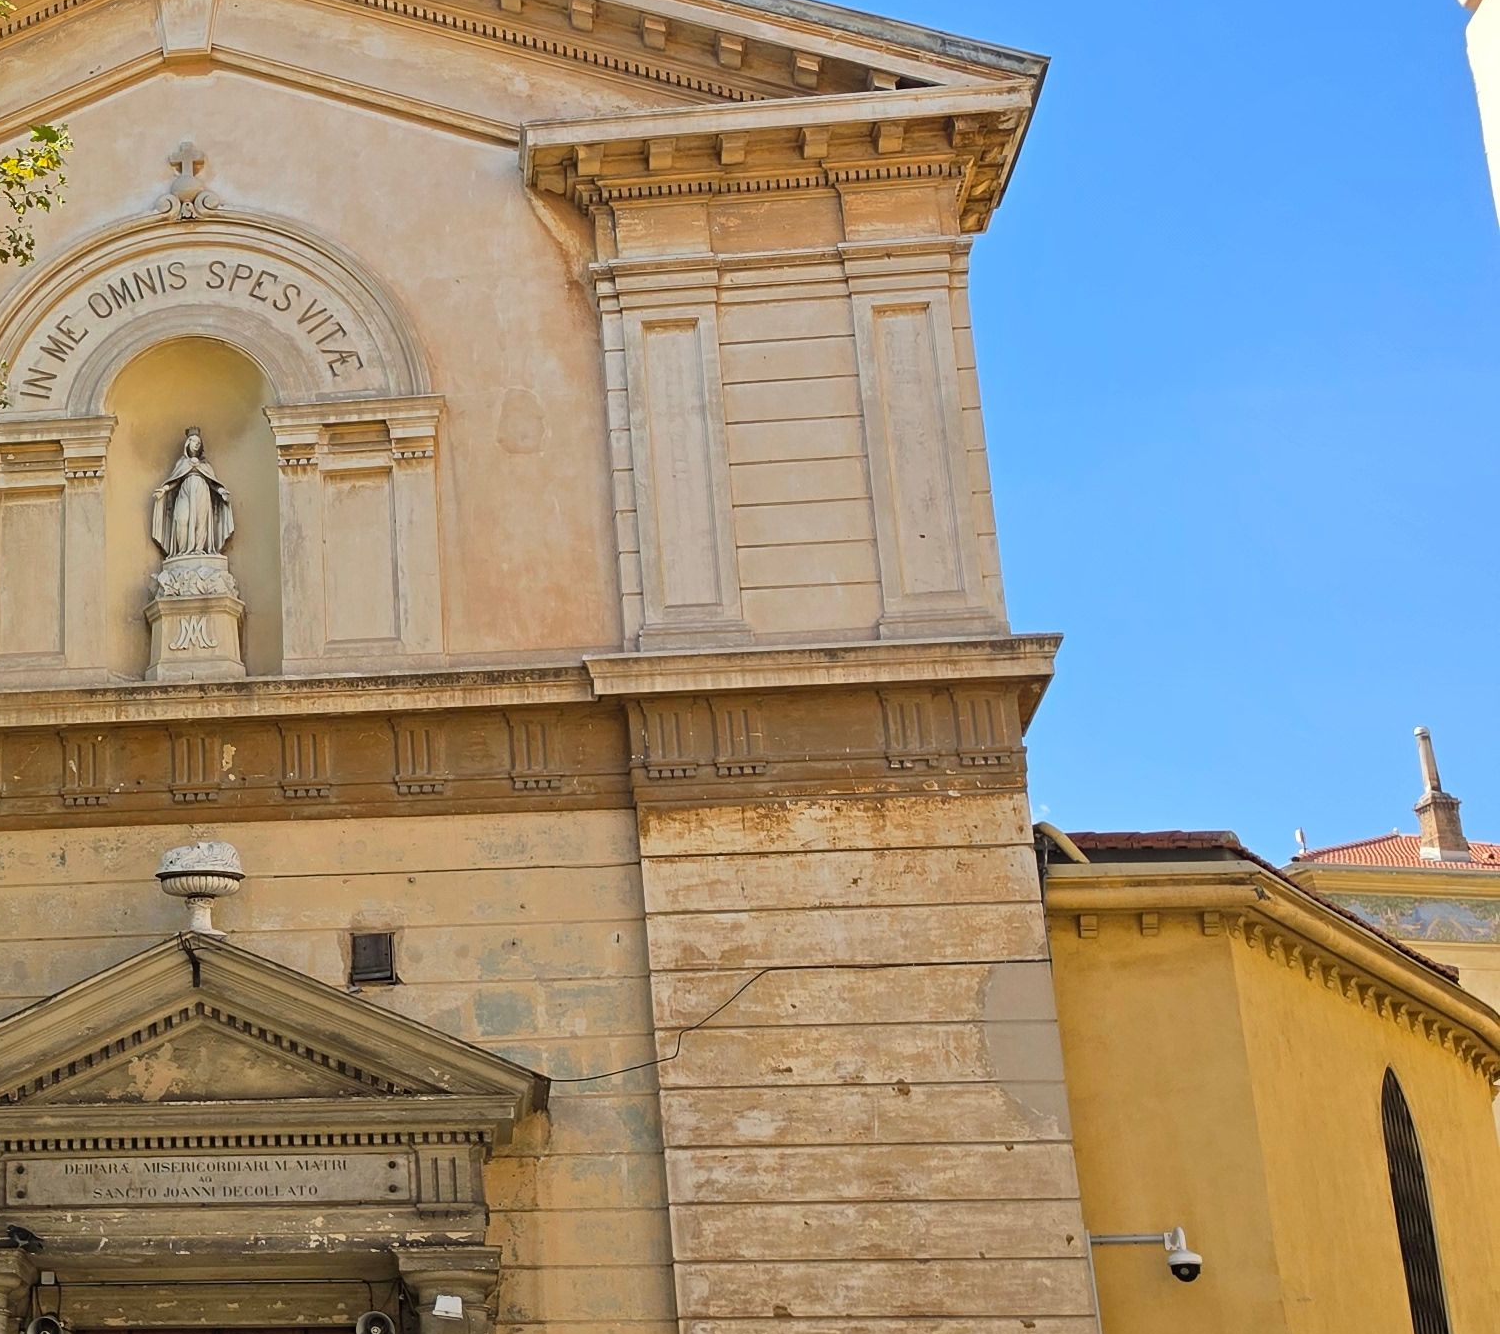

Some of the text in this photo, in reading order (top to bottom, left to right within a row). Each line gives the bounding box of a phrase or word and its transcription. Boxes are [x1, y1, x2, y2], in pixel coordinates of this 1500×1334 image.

[19, 260, 364, 399] IN ME OMNIS SPES VITÆ
[143, 1160, 288, 1174] MISERICORDIARUM
[296, 1159, 348, 1171] MATRI
[93, 1184, 318, 1199] SANCTO JOANNI DECOLLATO
